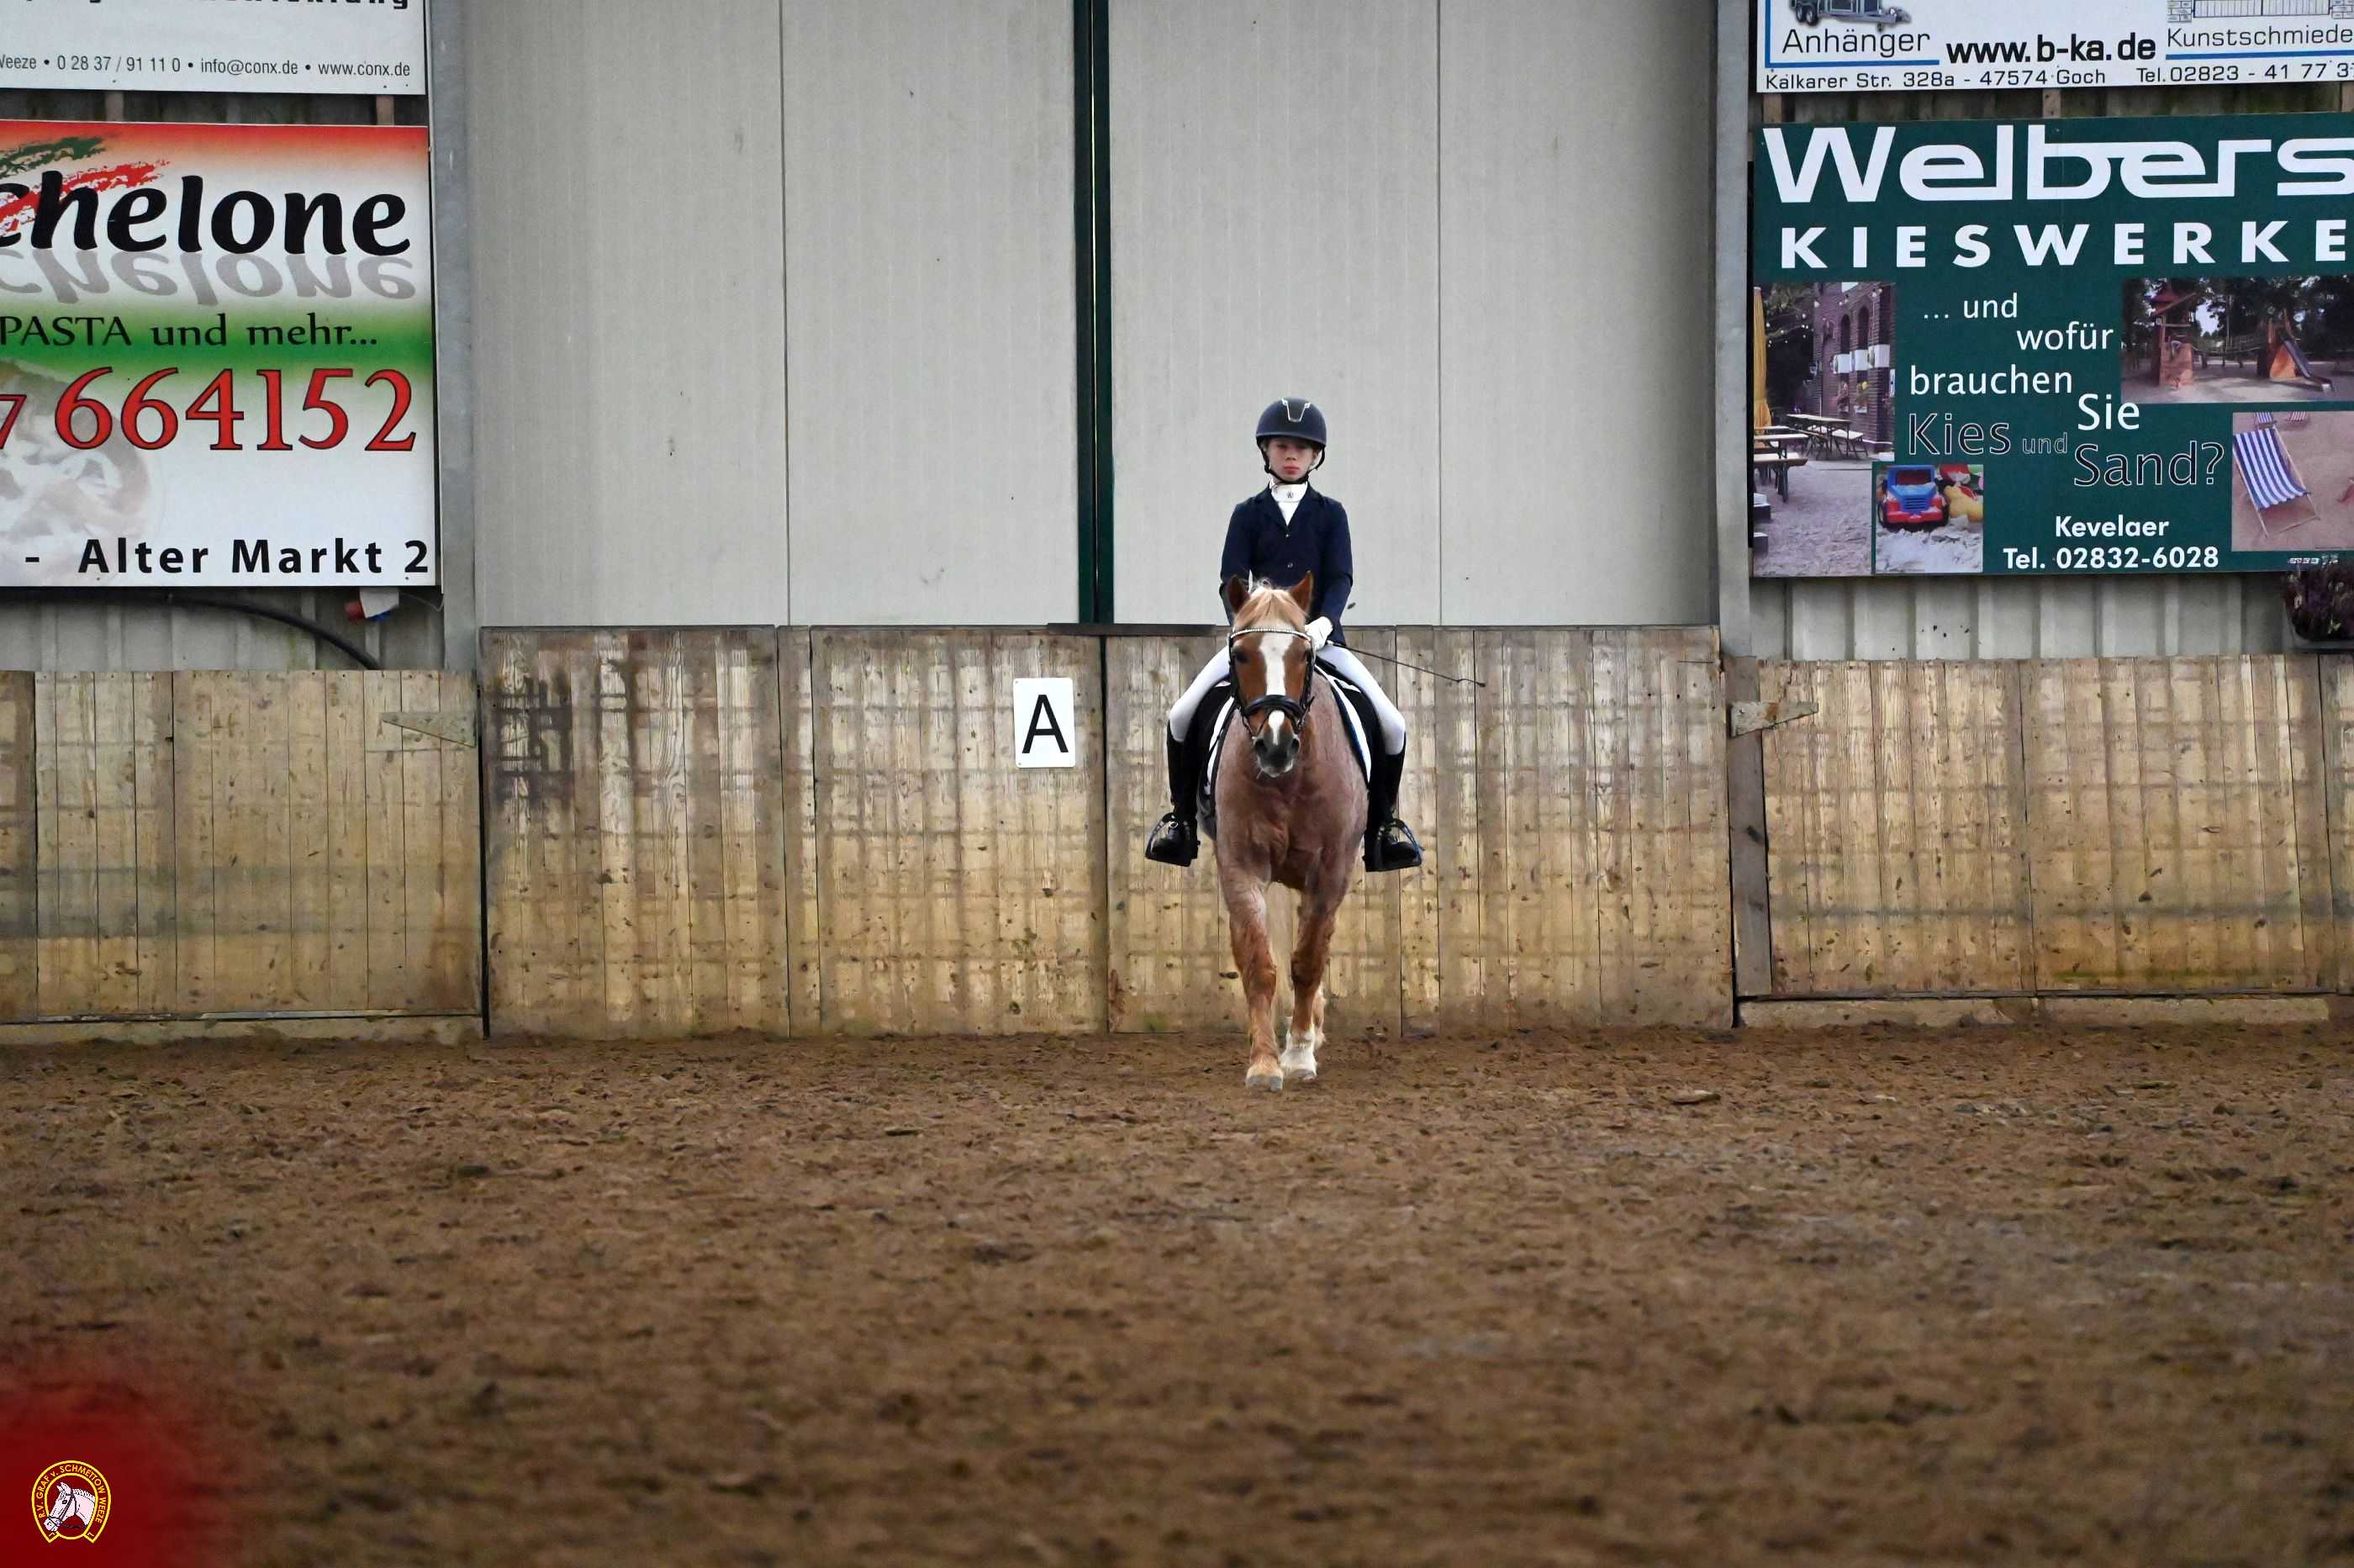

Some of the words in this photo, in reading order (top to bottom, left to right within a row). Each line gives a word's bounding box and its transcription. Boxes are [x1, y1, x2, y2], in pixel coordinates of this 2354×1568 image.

[1782, 29, 1931, 58] Anhänger
[2167, 24, 2353, 48] Kunstschmiede
[57, 55, 66, 70] 0
[71, 55, 89, 71] 28
[94, 56, 111, 71] 37
[126, 57, 143, 71] 91
[150, 57, 165, 72] 11
[172, 58, 181, 72] 0
[201, 58, 298, 76] info@conx.de
[318, 62, 410, 77] www.conx.de
[1766, 73, 1848, 90] Kalkarer
[1856, 73, 1892, 88] Str.
[1903, 72, 1955, 87] 328a
[1979, 71, 2048, 87] 47574
[2056, 67, 2106, 85] Goch
[2170, 65, 2240, 82] 02823
[2264, 64, 2288, 81] 41
[2301, 63, 2328, 80] 77
[1763, 124, 2354, 203] Welbers
[1781, 219, 2346, 269] KIESWERKE
[1962, 293, 2018, 319] und
[0, 316, 132, 346] PASTA
[151, 314, 227, 346] und
[246, 314, 378, 346] mehr...
[2016, 321, 2114, 351] wofür
[1910, 365, 2072, 395] brauchen
[0, 393, 28, 451] 7
[54, 367, 417, 451] 664152
[2077, 393, 2140, 430] Sie
[1908, 412, 2013, 456] Kies
[2021, 432, 2069, 455] und
[2072, 441, 2225, 488] Sand?
[2055, 515, 2171, 539] Kevelaer
[77, 538, 209, 573] Alter
[231, 538, 383, 573] Markt
[404, 541, 429, 573] 2
[2003, 547, 2046, 570] Tel.
[2055, 546, 2219, 570] 02832-6028
[1021, 694, 1069, 754] A
